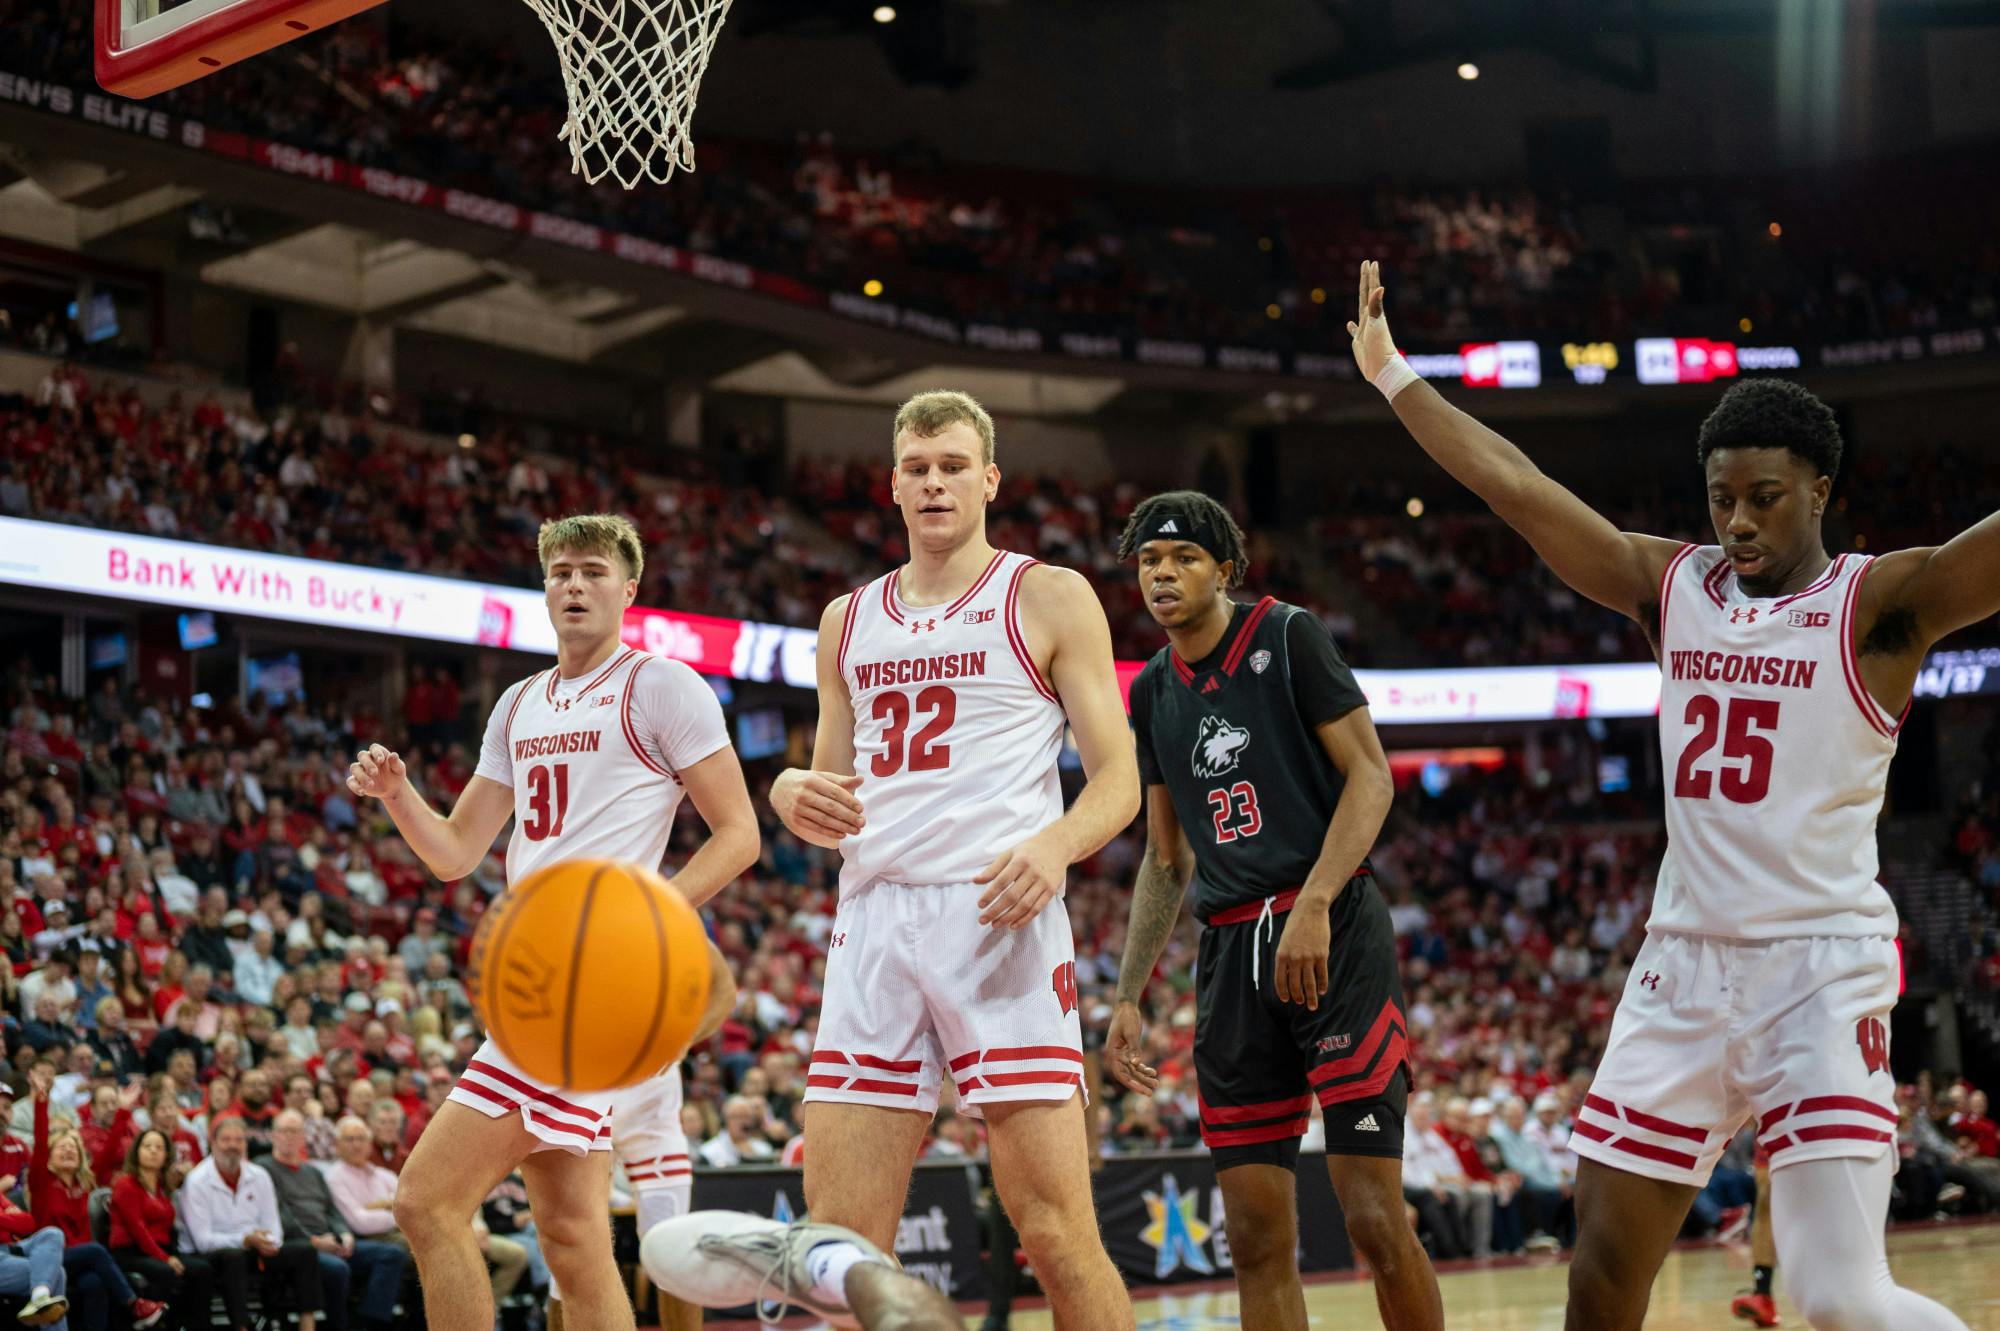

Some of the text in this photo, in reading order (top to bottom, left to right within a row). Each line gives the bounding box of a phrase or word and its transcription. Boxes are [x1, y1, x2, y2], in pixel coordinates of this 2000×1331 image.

[83, 94, 169, 139] ELITE
[182, 120, 205, 148] 8
[108, 547, 405, 626] Bank With Bucky
[854, 651, 987, 690] WISCONSIN
[1670, 649, 1818, 689] WISCONSIN
[514, 730, 602, 762] WISCONSIN
[870, 685, 957, 778] 32
[1674, 694, 1781, 804] 25
[523, 763, 569, 842] 31
[1207, 779, 1263, 845] 23
[1316, 1033, 1352, 1054] NIU
[1355, 1124, 1380, 1132] adidas
